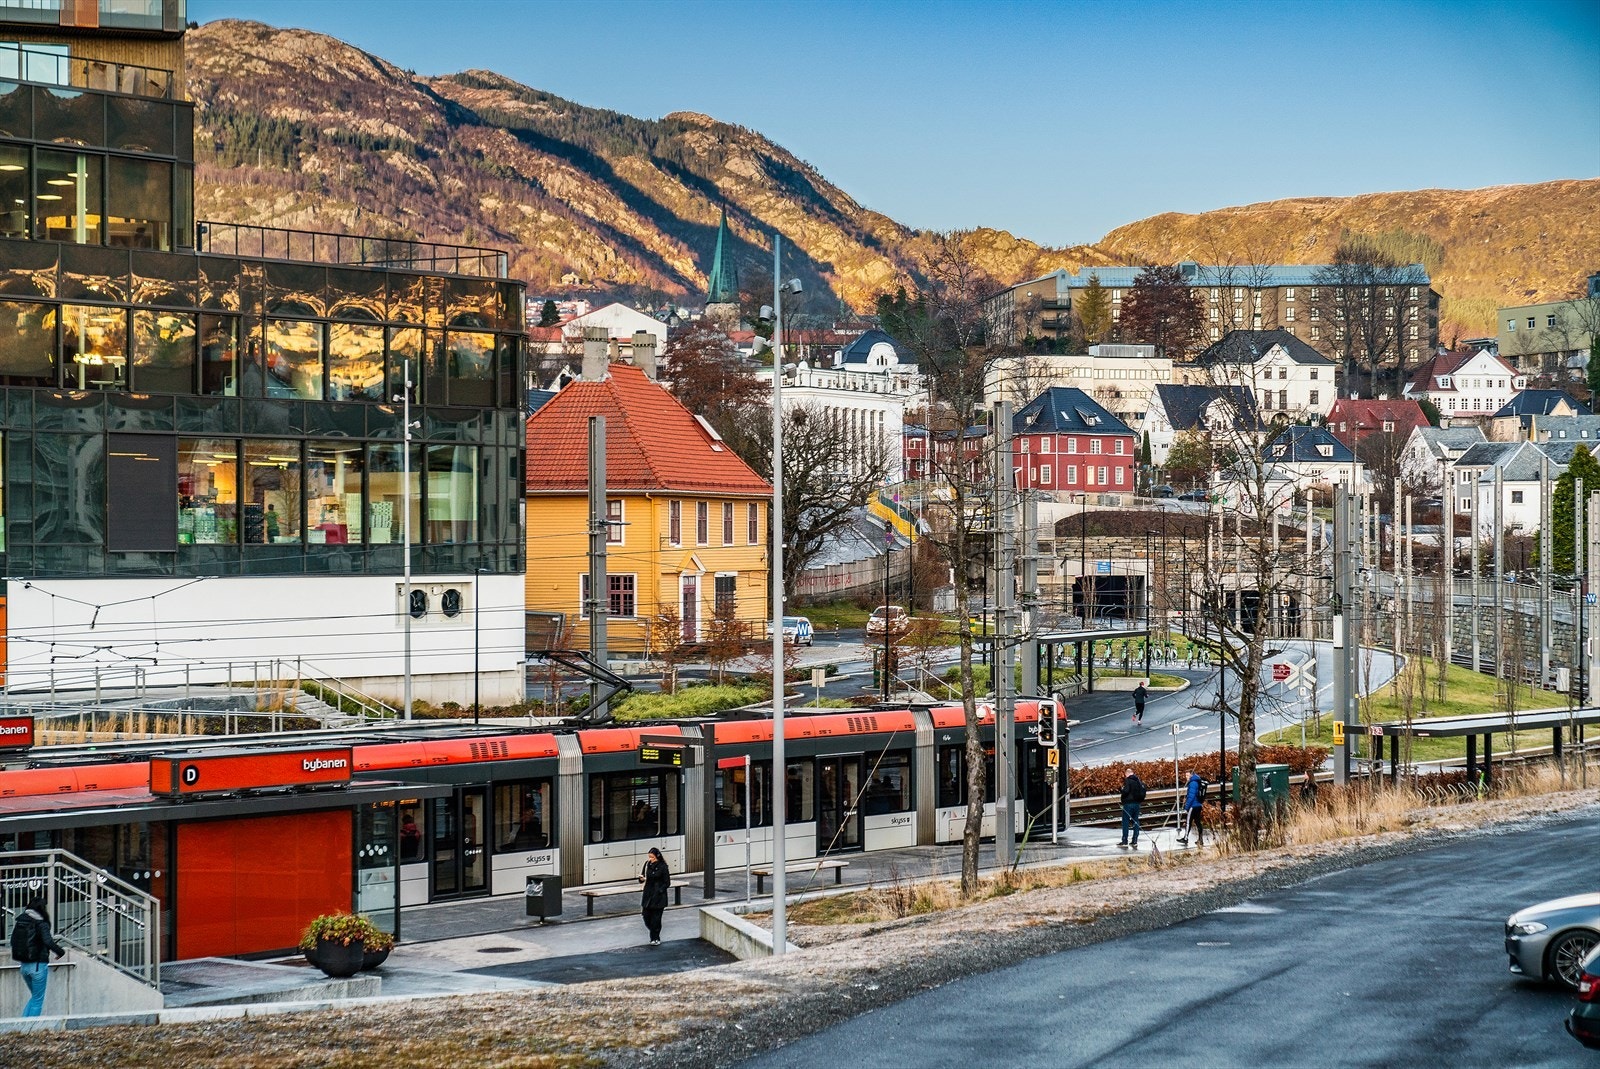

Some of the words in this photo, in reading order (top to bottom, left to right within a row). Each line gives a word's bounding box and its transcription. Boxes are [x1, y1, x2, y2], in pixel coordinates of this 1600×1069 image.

[798, 623, 809, 635] W
[303, 758, 347, 772] bybanen
[1051, 751, 1056, 765] 2
[186, 768, 197, 782] D
[526, 854, 546, 865] skyss
